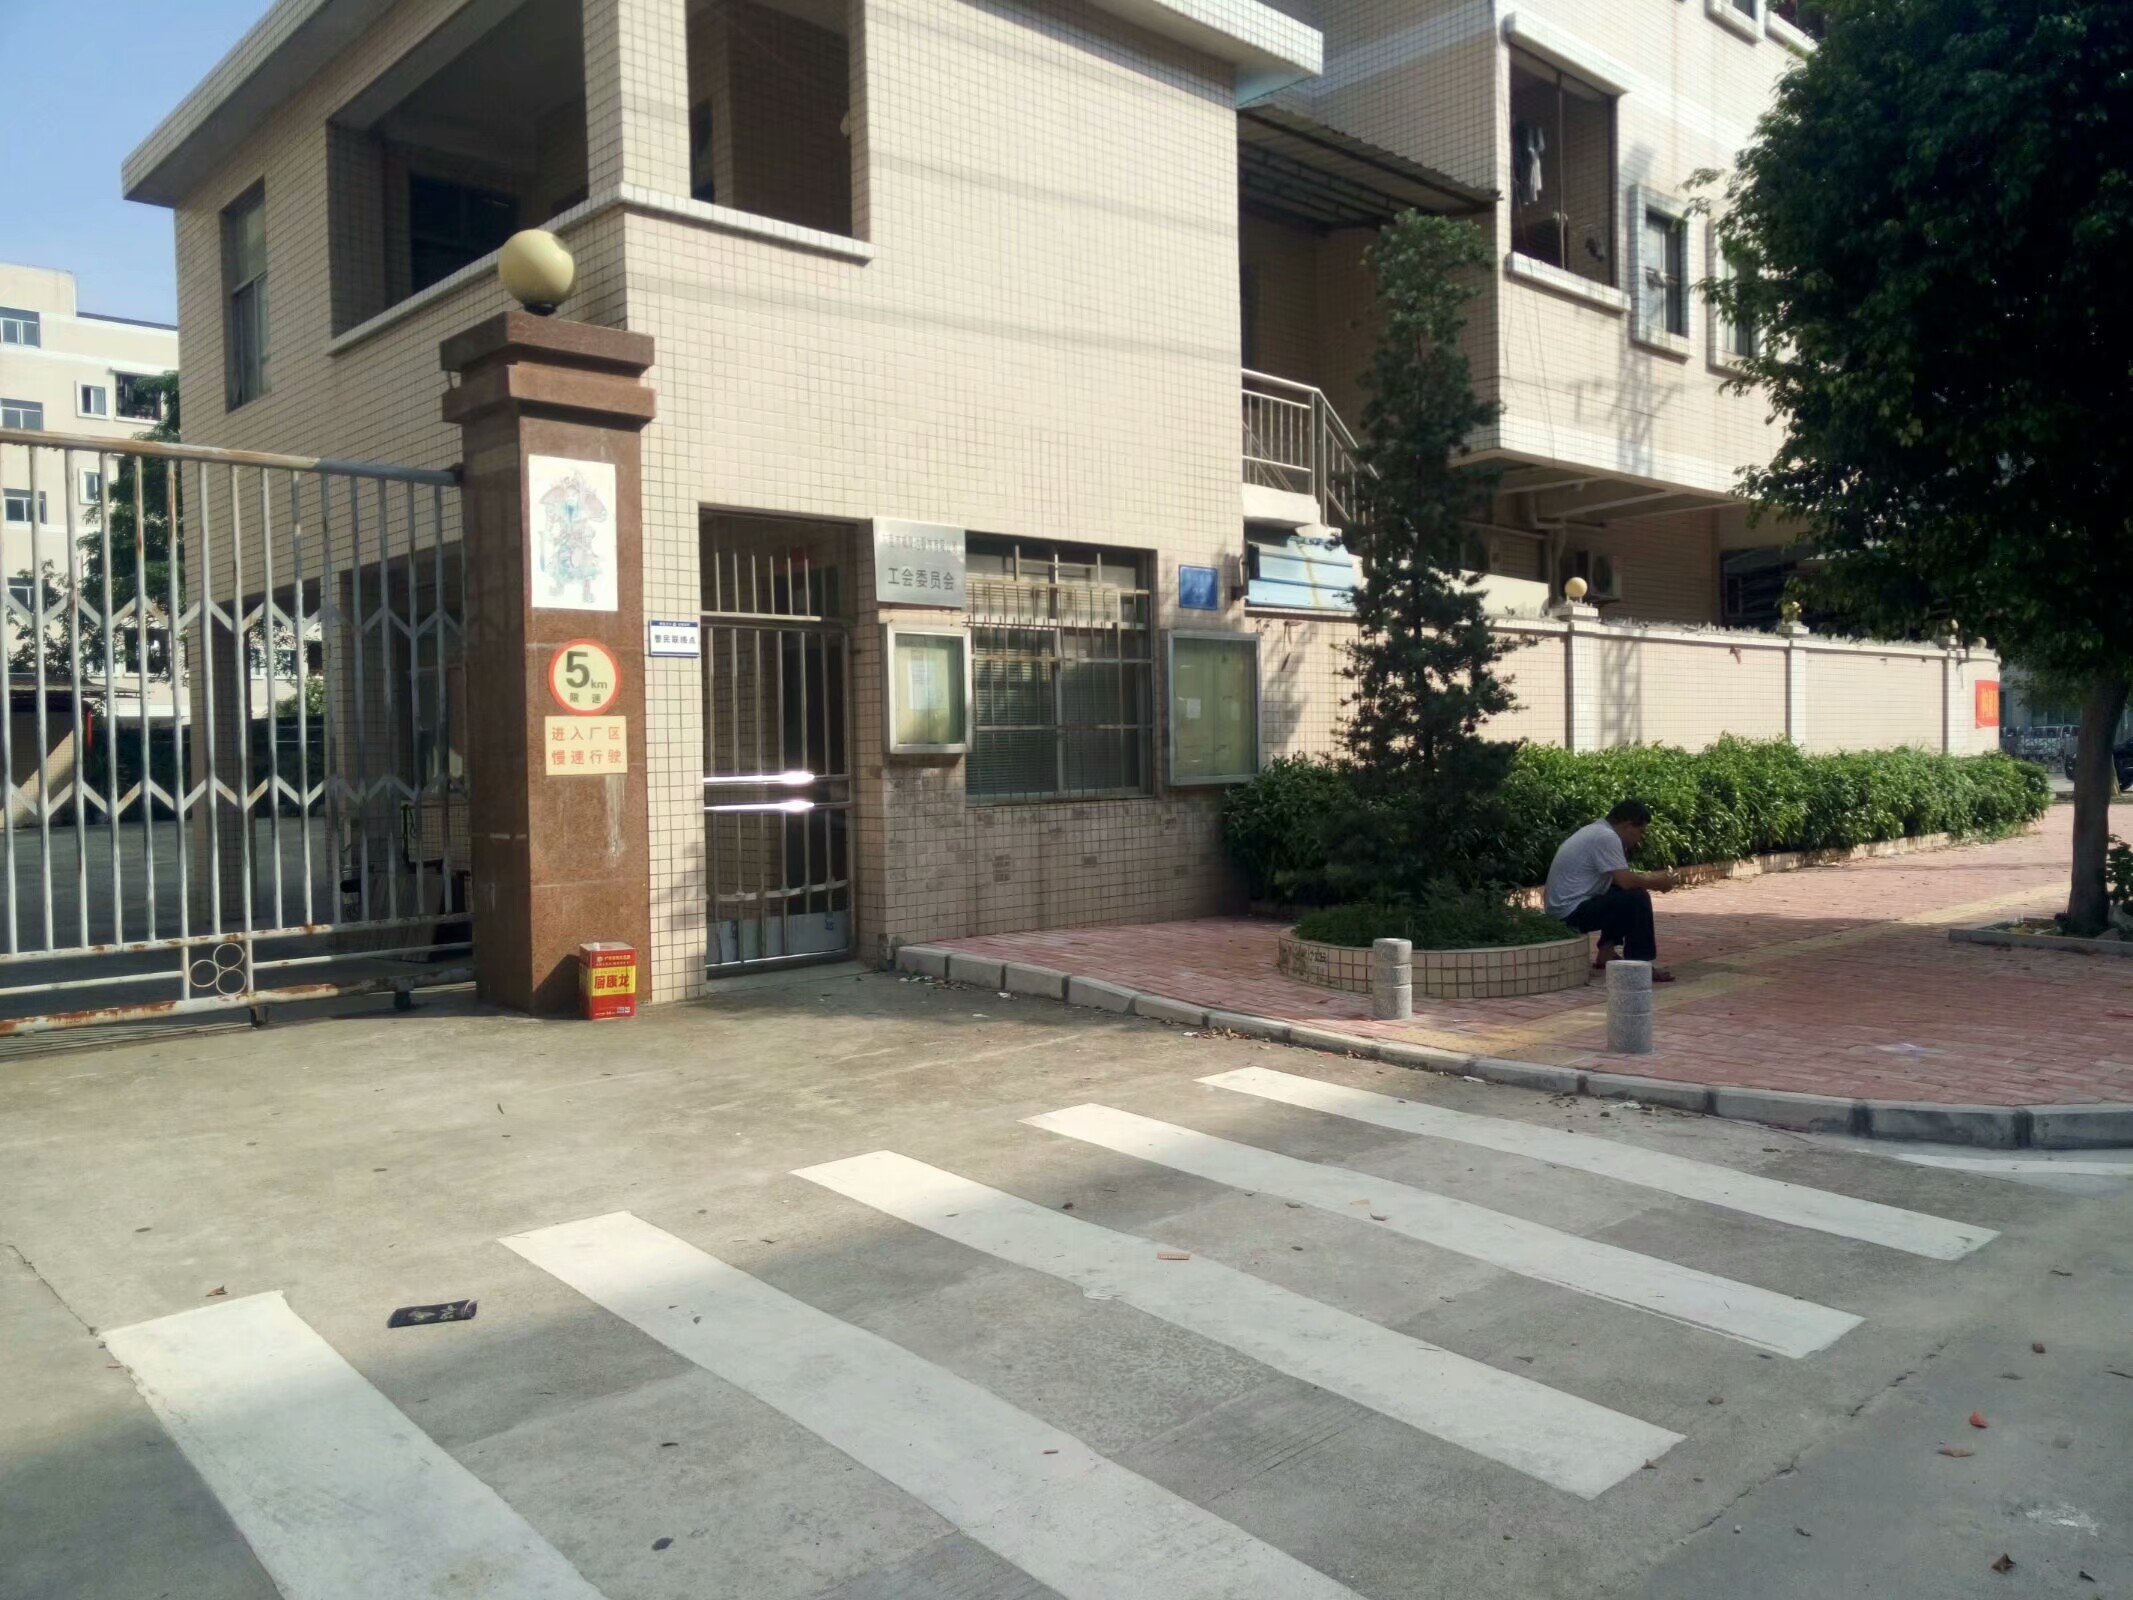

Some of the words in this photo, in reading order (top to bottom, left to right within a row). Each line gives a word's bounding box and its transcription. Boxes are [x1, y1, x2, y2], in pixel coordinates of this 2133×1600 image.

[888, 567, 954, 590] 工会委员会
[569, 692, 602, 704] 限速
[551, 726, 621, 741] 进入厂区
[551, 748, 622, 766] 慢速行驶
